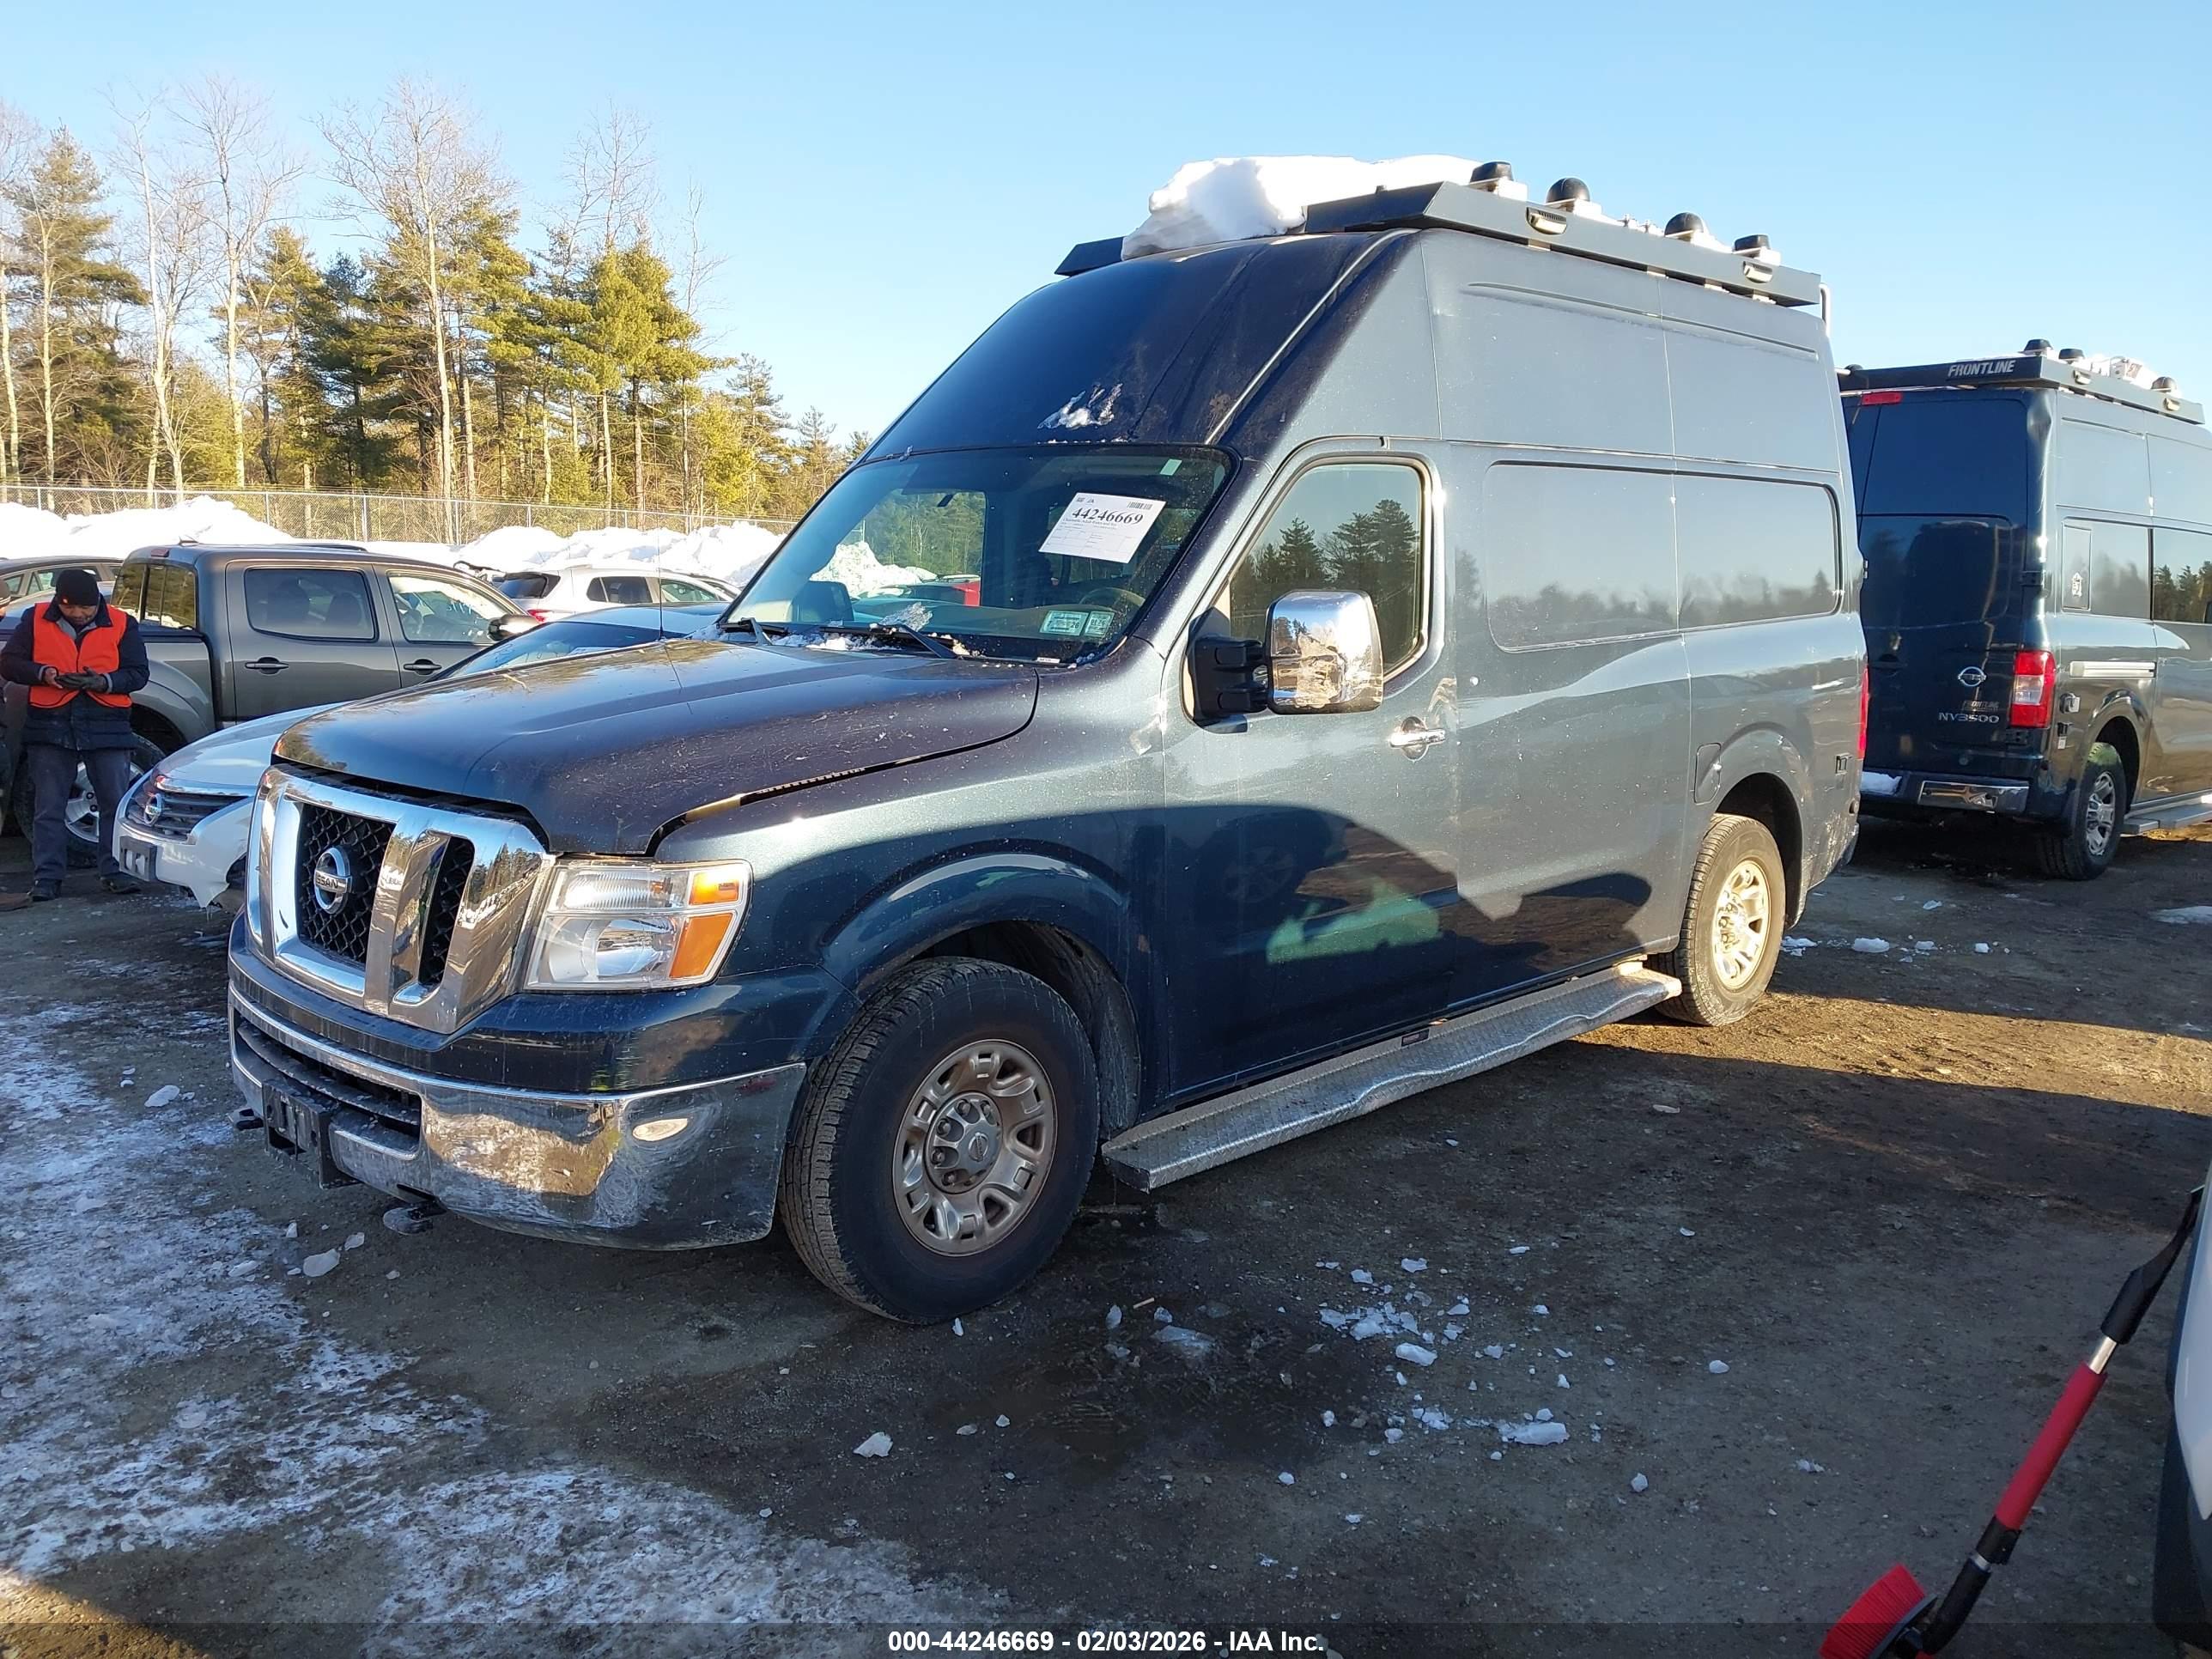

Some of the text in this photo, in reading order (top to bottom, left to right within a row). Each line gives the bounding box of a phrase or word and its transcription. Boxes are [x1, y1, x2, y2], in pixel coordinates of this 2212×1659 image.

[1948, 360, 2016, 377] FRONTLINE
[1072, 507, 1144, 525] 44246669
[1938, 712, 2000, 723] NV3500
